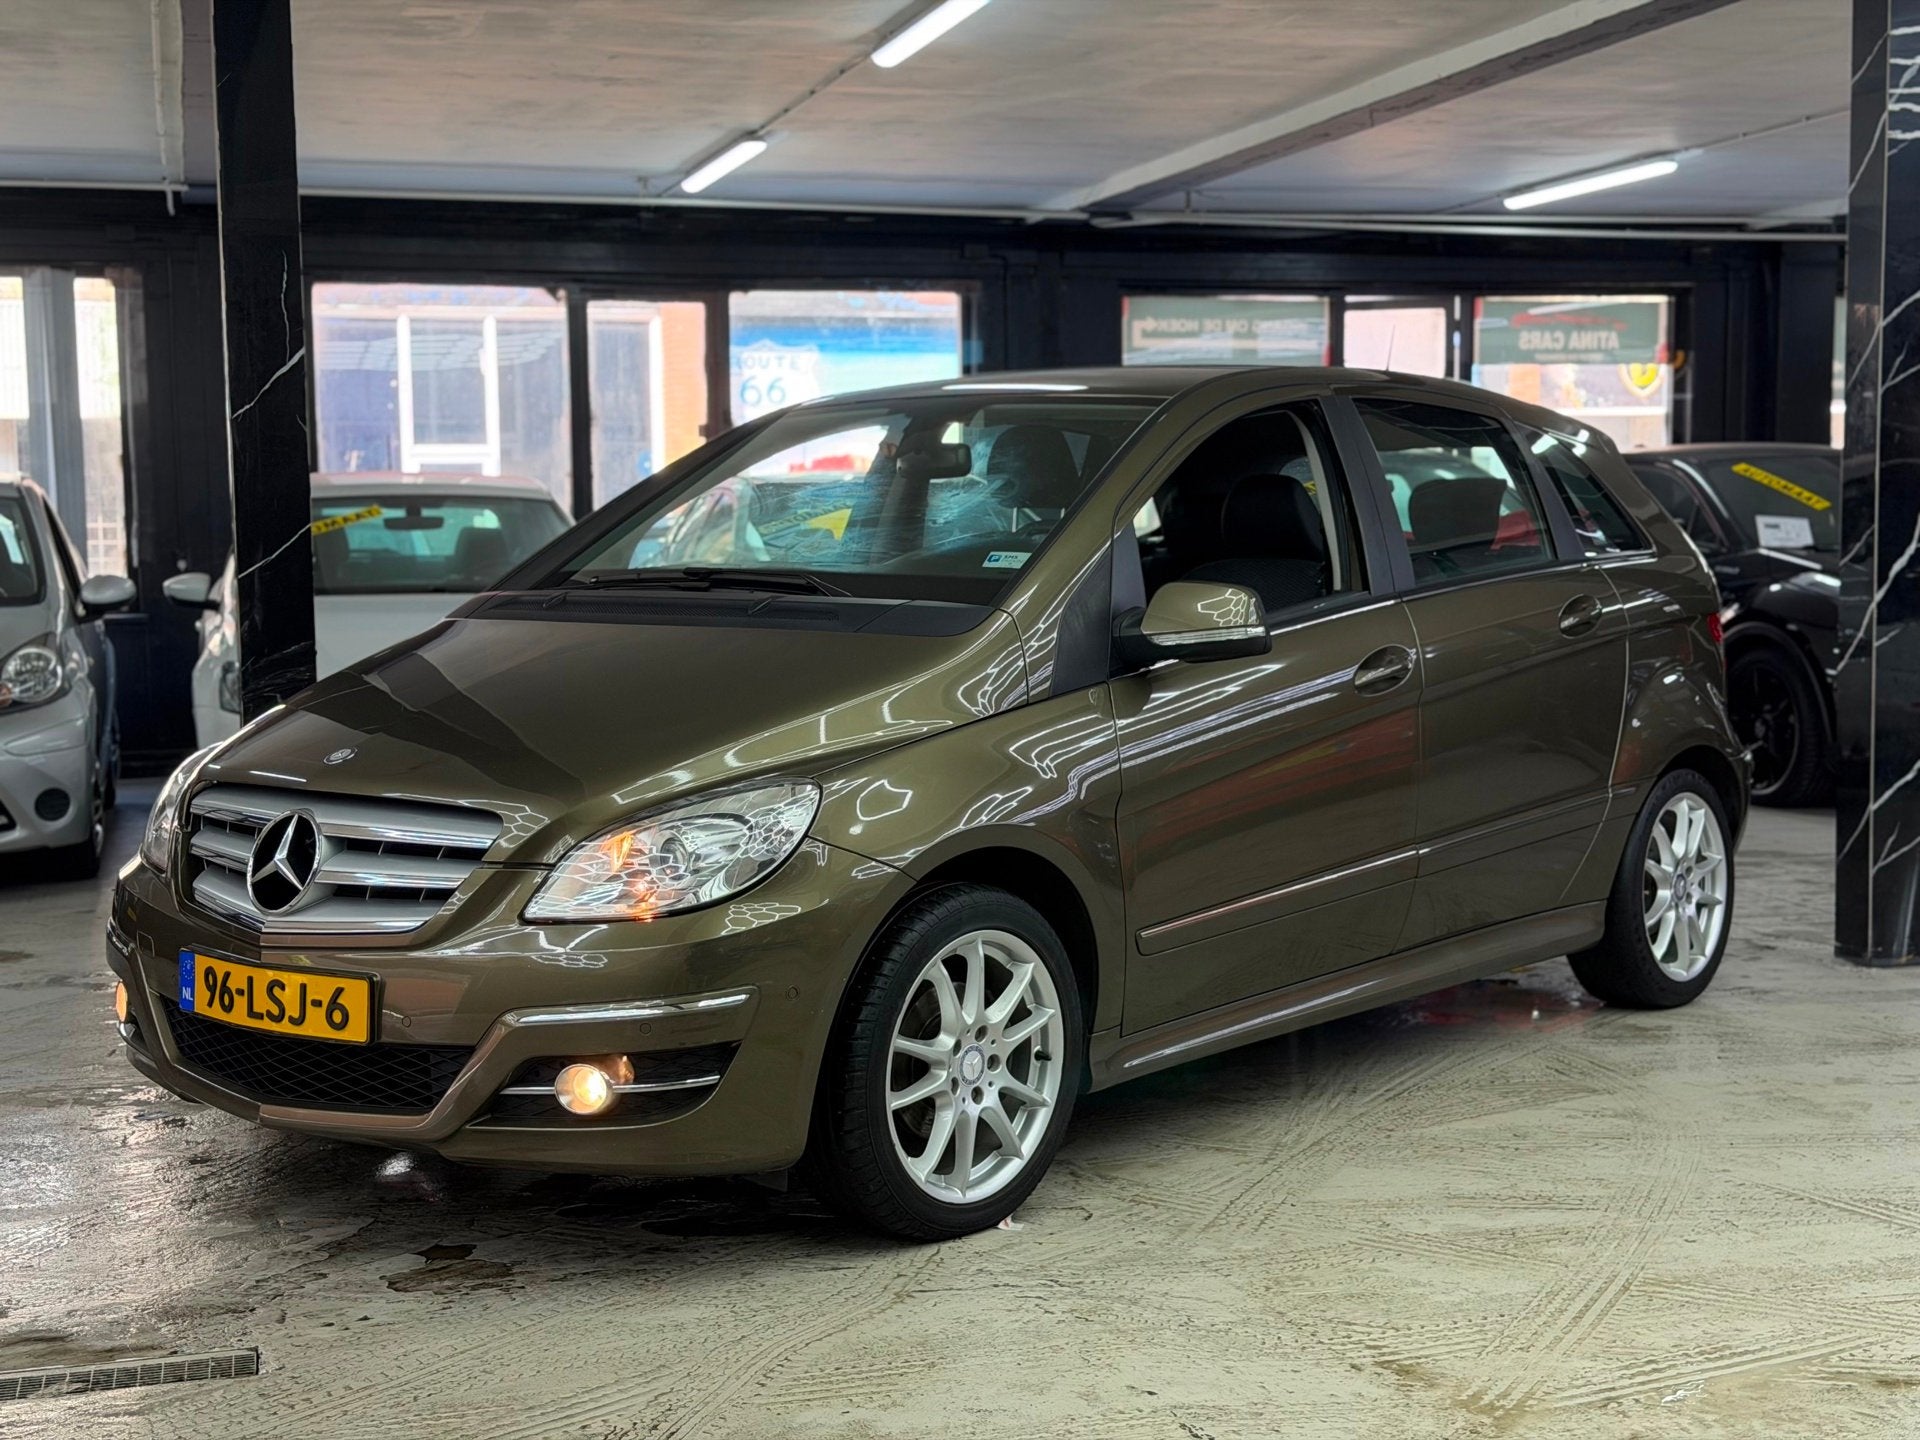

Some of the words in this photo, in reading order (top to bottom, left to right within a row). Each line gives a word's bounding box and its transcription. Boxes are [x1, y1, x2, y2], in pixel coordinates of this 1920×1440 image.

[740, 375, 786, 408] 66
[182, 986, 194, 1001] NL
[203, 965, 350, 1031] 96-LSJ-6
